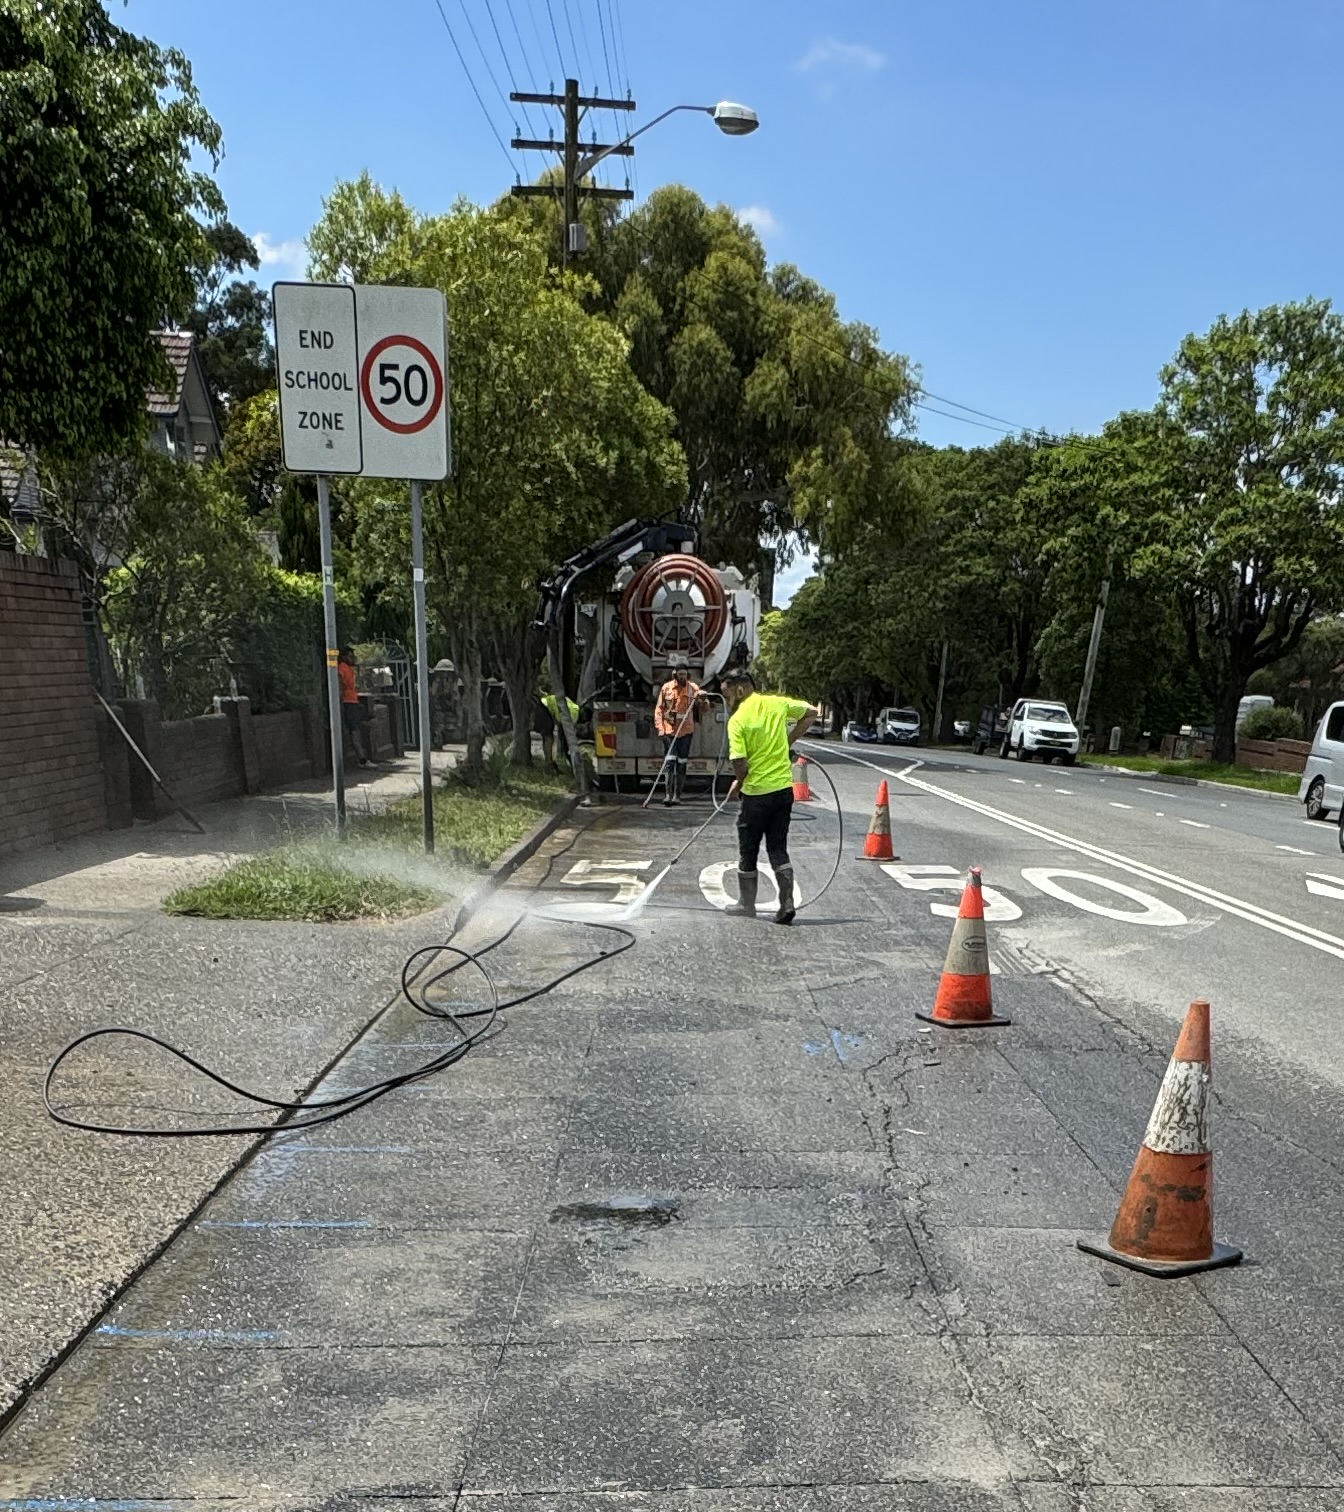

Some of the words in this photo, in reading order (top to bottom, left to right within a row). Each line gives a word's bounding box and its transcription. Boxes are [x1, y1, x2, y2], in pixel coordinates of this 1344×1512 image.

[299, 330, 334, 350] END
[284, 370, 354, 391] SCHOOL
[379, 363, 429, 407] 50
[298, 411, 345, 431] ZONE
[879, 864, 1189, 927] 50
